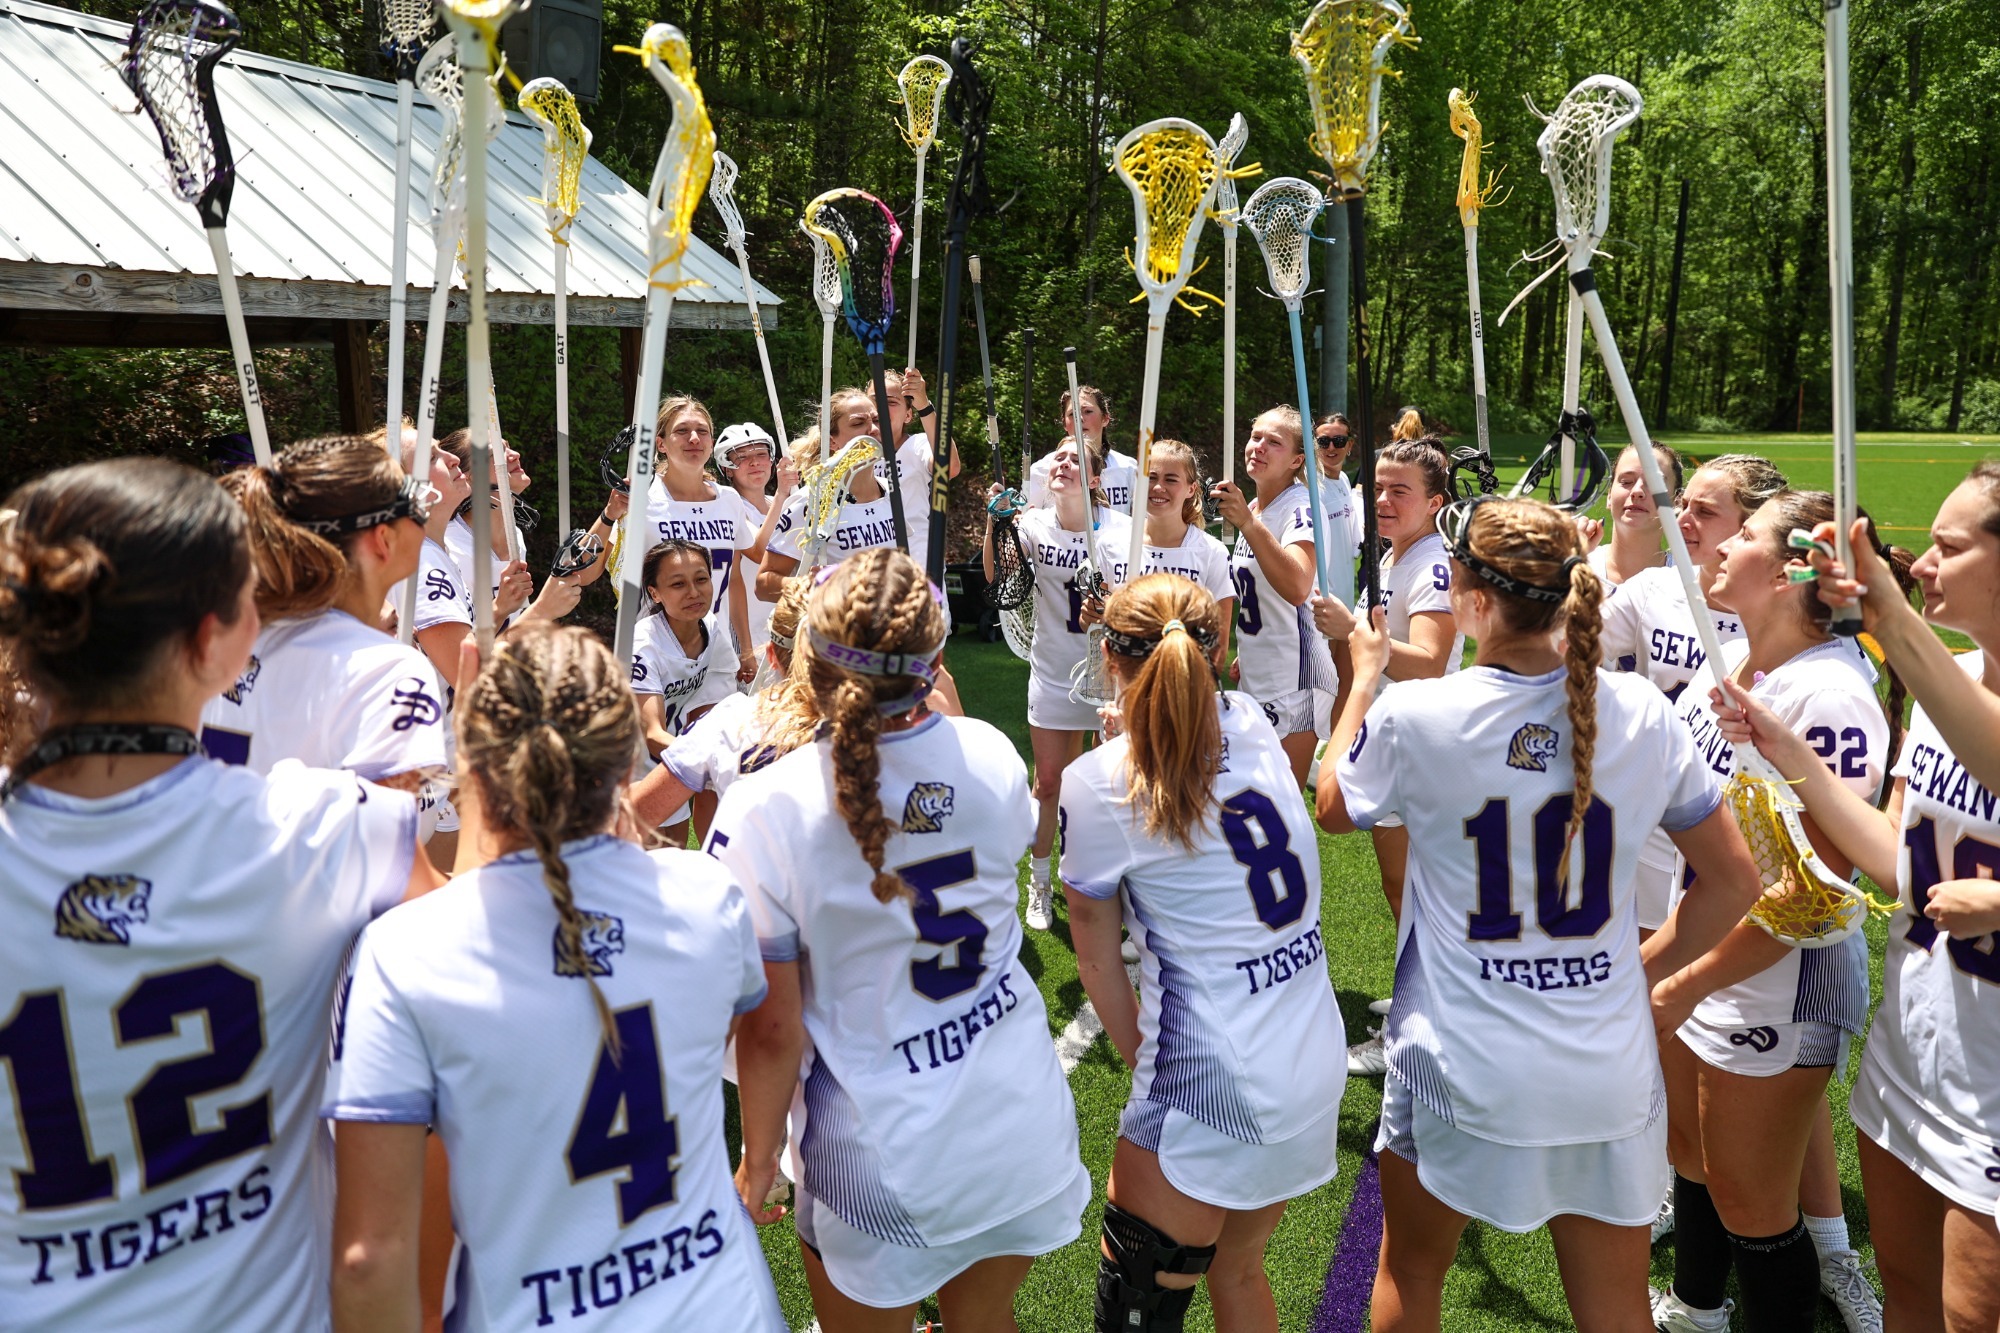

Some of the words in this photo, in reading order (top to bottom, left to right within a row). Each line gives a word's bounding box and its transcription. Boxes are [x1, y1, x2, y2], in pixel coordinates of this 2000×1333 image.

[556, 333, 565, 365] GAIT
[1473, 310, 1482, 338] GAIT
[243, 363, 260, 407] GAIT
[427, 376, 439, 419] GAIT
[636, 424, 652, 475] GAIT
[931, 461, 949, 513] STX
[356, 507, 397, 529] STX
[658, 519, 736, 542] SEWANEE
[1432, 563, 1450, 592] 9
[1479, 566, 1515, 593] STX
[827, 643, 874, 668] STX
[1805, 726, 1869, 779] 22
[1217, 785, 1309, 934] 8
[1462, 789, 1617, 943] 10
[892, 845, 989, 1005] 5
[893, 972, 1018, 1074] TIGERS
[0, 956, 277, 1214] 12
[563, 999, 683, 1230] 4
[17, 1164, 273, 1285] TIGERS
[1741, 1223, 1806, 1253] Compression
[521, 1208, 725, 1328] TIGERS
